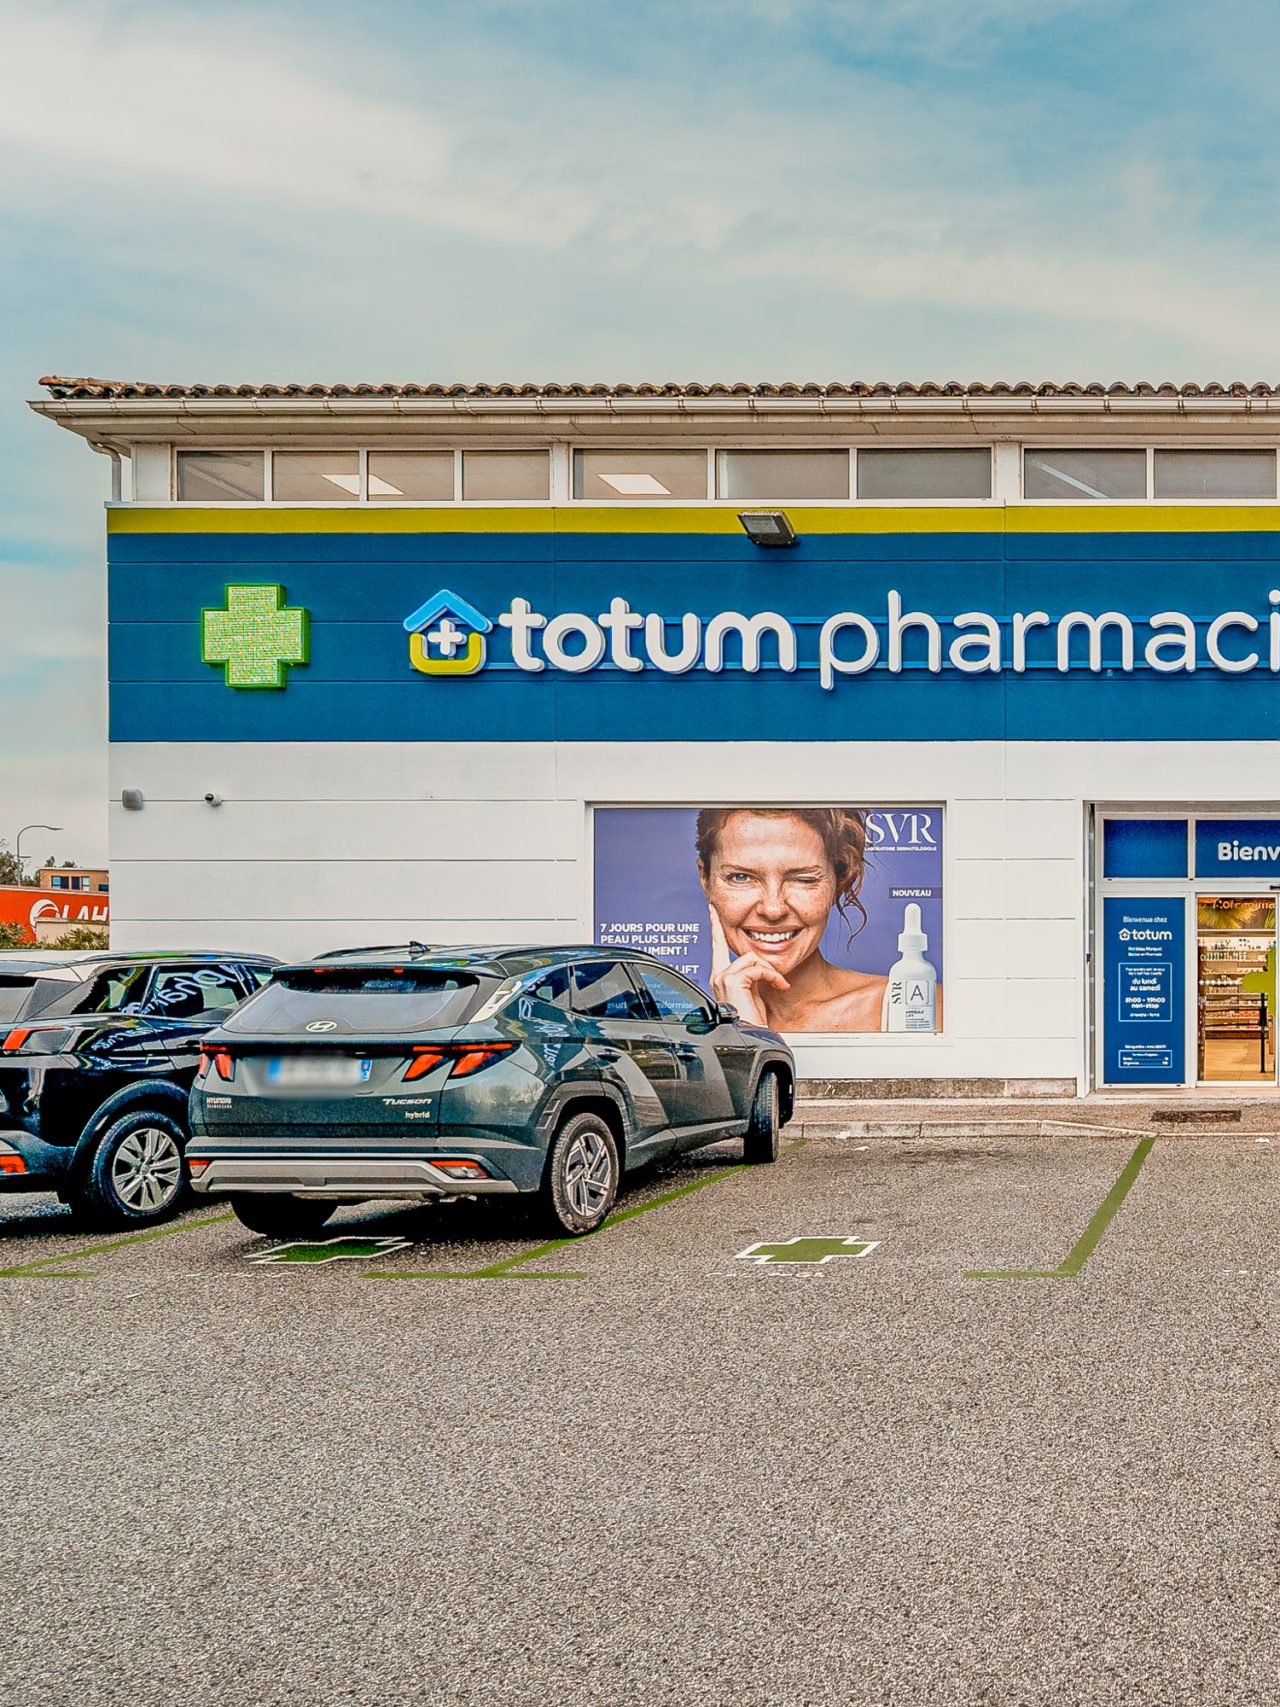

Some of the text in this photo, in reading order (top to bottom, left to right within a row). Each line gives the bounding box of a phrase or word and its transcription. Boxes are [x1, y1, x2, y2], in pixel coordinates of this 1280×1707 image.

[499, 597, 798, 673] totum
[865, 813, 937, 844] SVR
[892, 889, 932, 897] NOUVEAU
[600, 923, 700, 933] 7 JOURS POUR UNE
[1131, 928, 1173, 940] totum
[600, 935, 630, 944] PEAU
[631, 935, 659, 944] PLUS
[404, 1111, 430, 1120] hybrid
